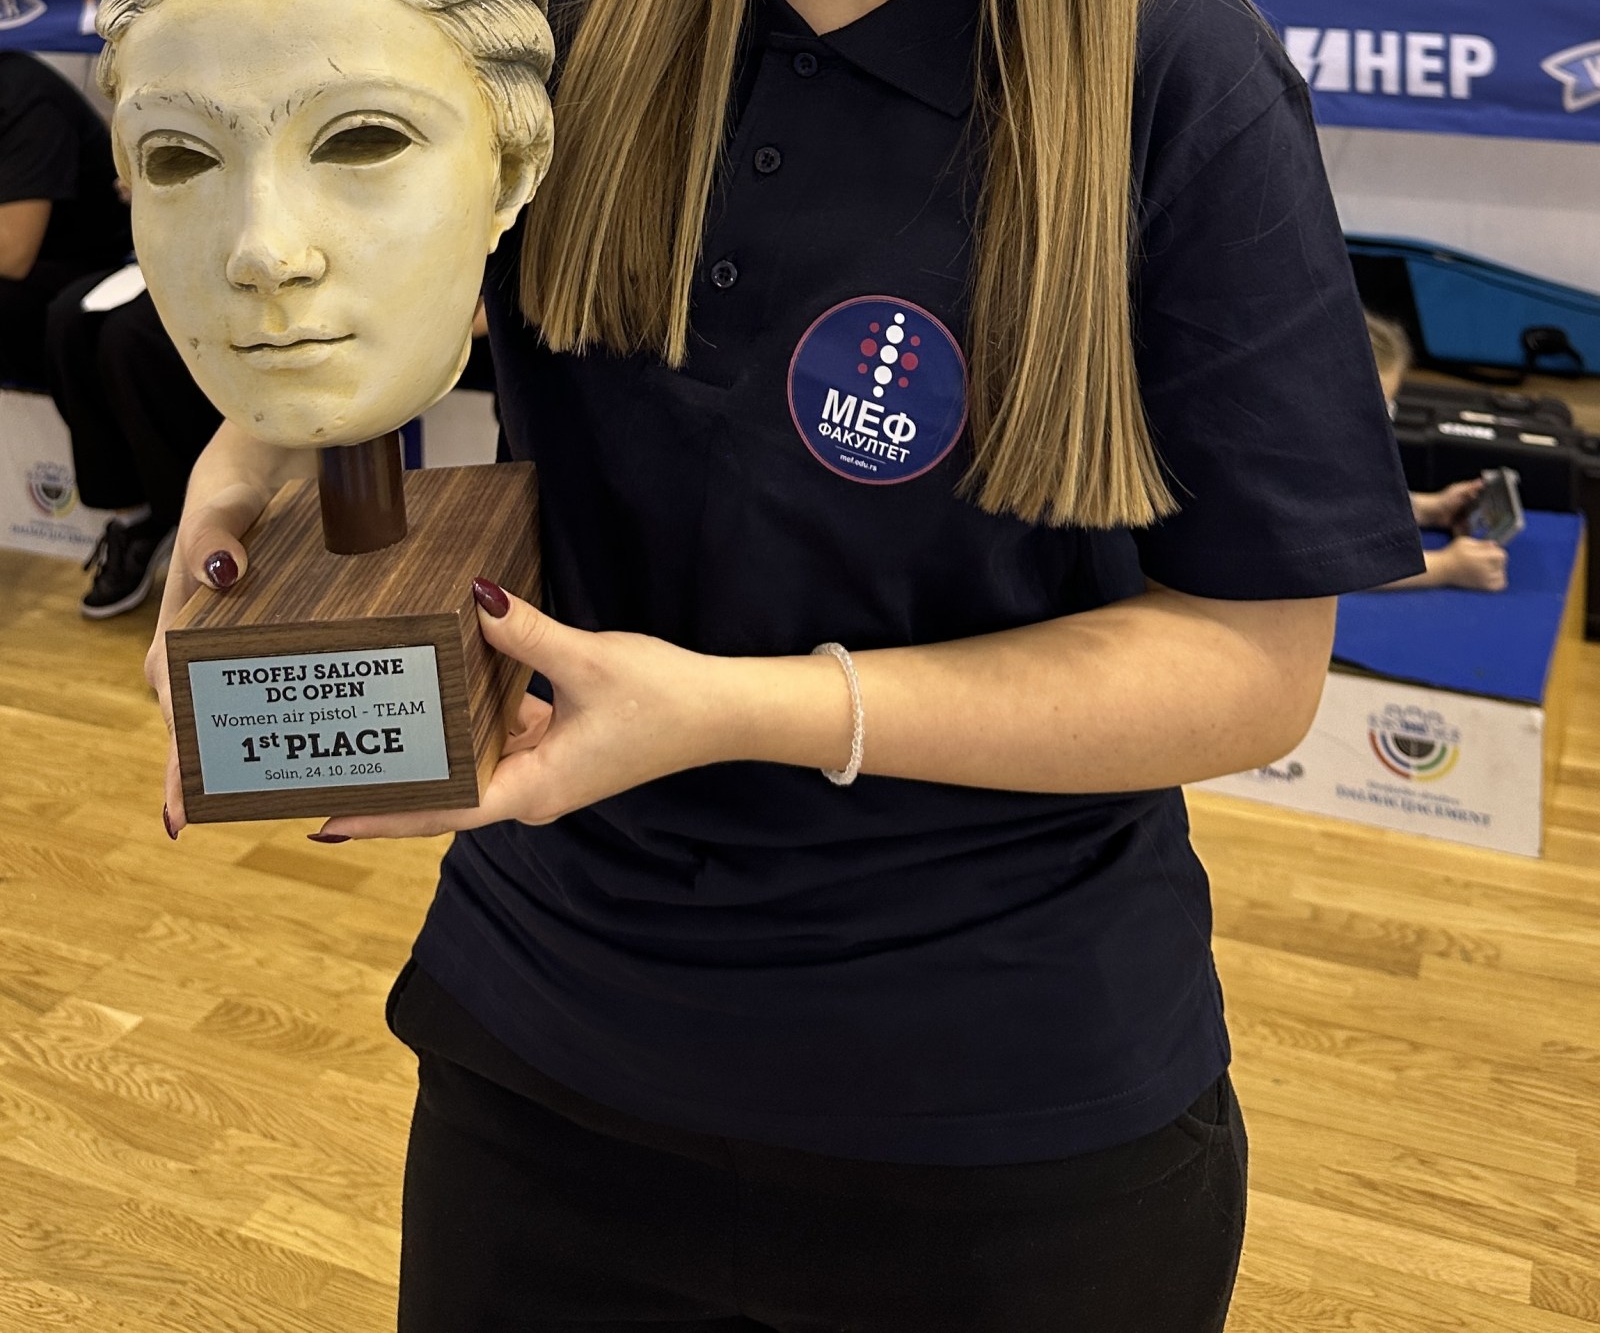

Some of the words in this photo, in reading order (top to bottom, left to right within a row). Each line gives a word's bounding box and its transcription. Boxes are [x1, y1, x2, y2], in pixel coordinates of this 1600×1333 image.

[1354, 28, 1497, 100] HEP
[821, 387, 917, 445] МЕФ
[818, 421, 910, 464] ФАКУЛТЕТ
[221, 664, 308, 686] TROFEJ
[313, 657, 405, 680] SALONE
[265, 686, 298, 704] DC
[302, 681, 365, 702] OPEN
[210, 713, 278, 728] Women
[282, 709, 305, 724] air
[309, 704, 358, 726] pistol
[373, 700, 426, 717] TEAM
[241, 731, 280, 763] 1st
[284, 727, 405, 760] PLACE
[264, 768, 302, 781] Solin,
[305, 766, 326, 779] 24.
